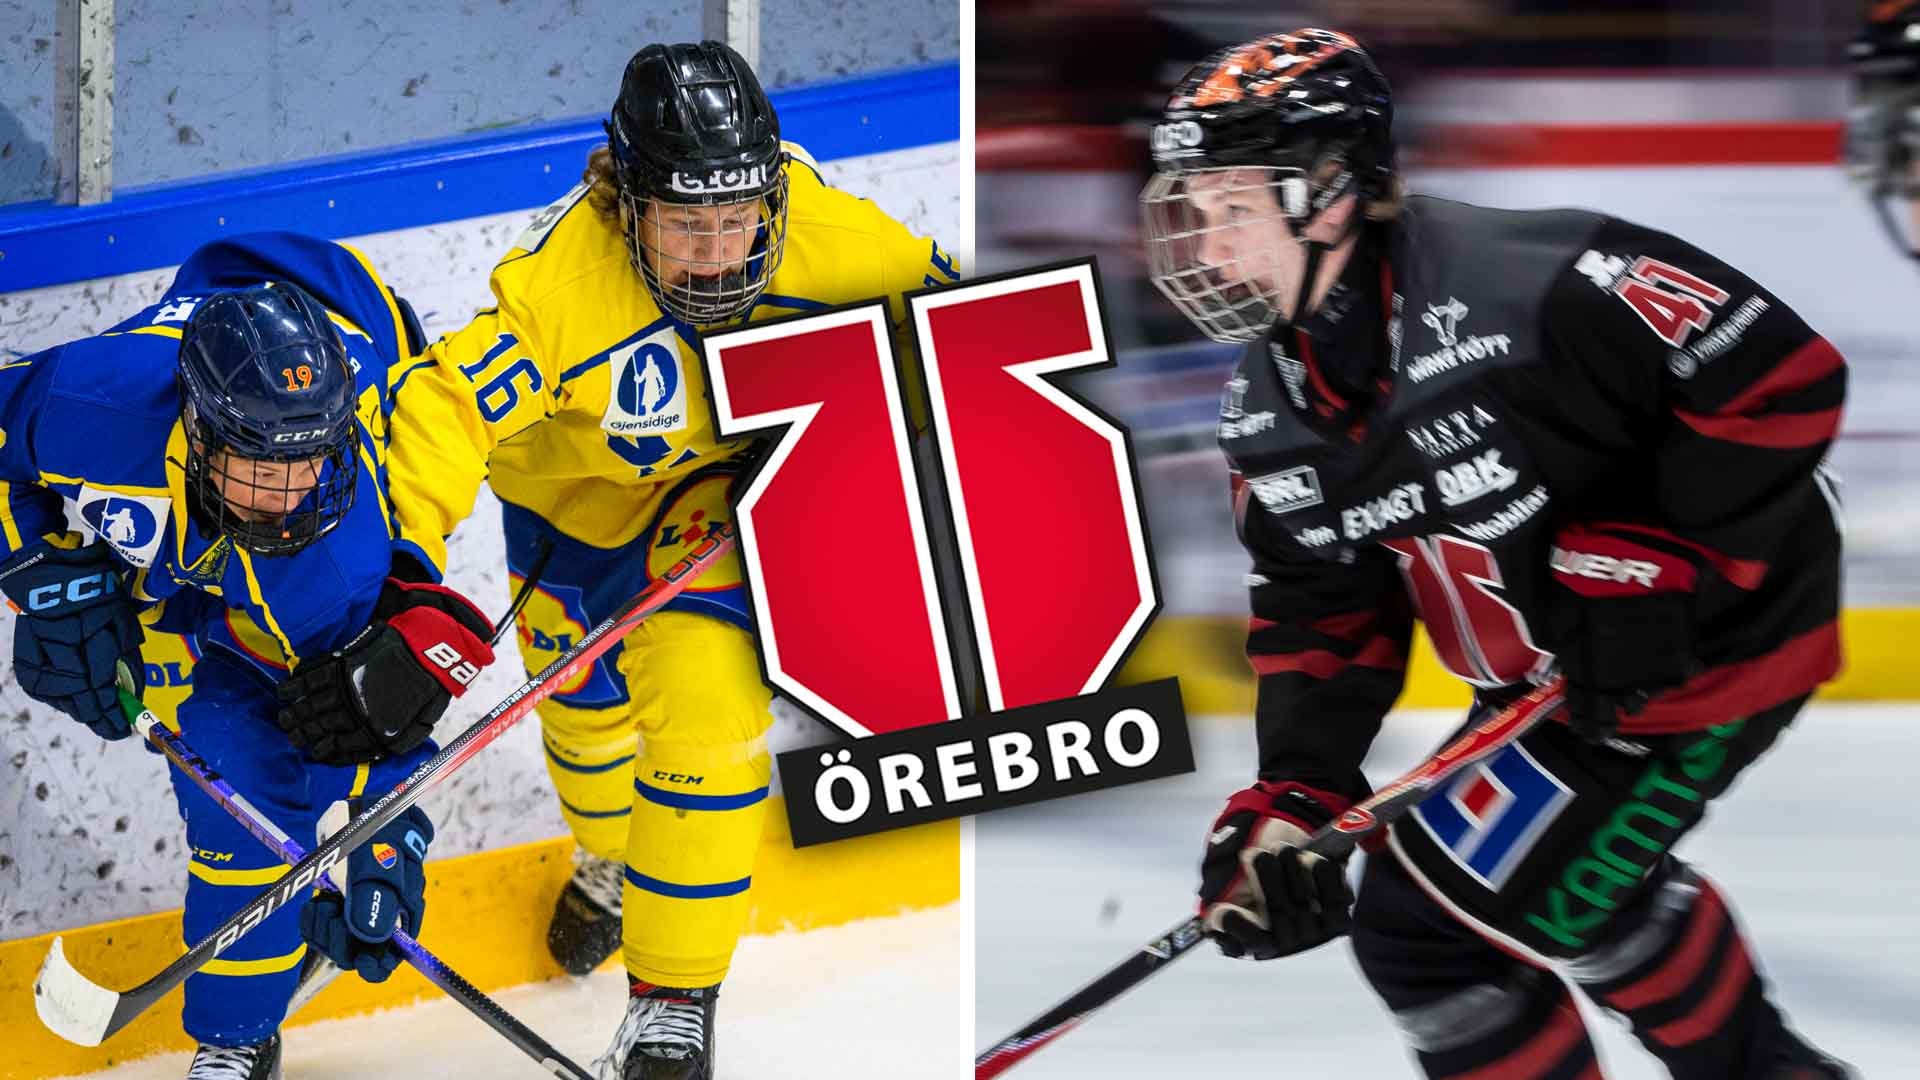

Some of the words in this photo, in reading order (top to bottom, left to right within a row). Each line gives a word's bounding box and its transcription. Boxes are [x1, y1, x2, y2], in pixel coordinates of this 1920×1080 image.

[1614, 255, 1731, 349] 41
[282, 365, 313, 392] 19
[457, 332, 543, 424] 16
[273, 427, 329, 442] CCM
[610, 413, 681, 432] Gjensidige
[143, 661, 193, 687] DL
[653, 770, 705, 785] CCM
[368, 890, 382, 928] CCM
